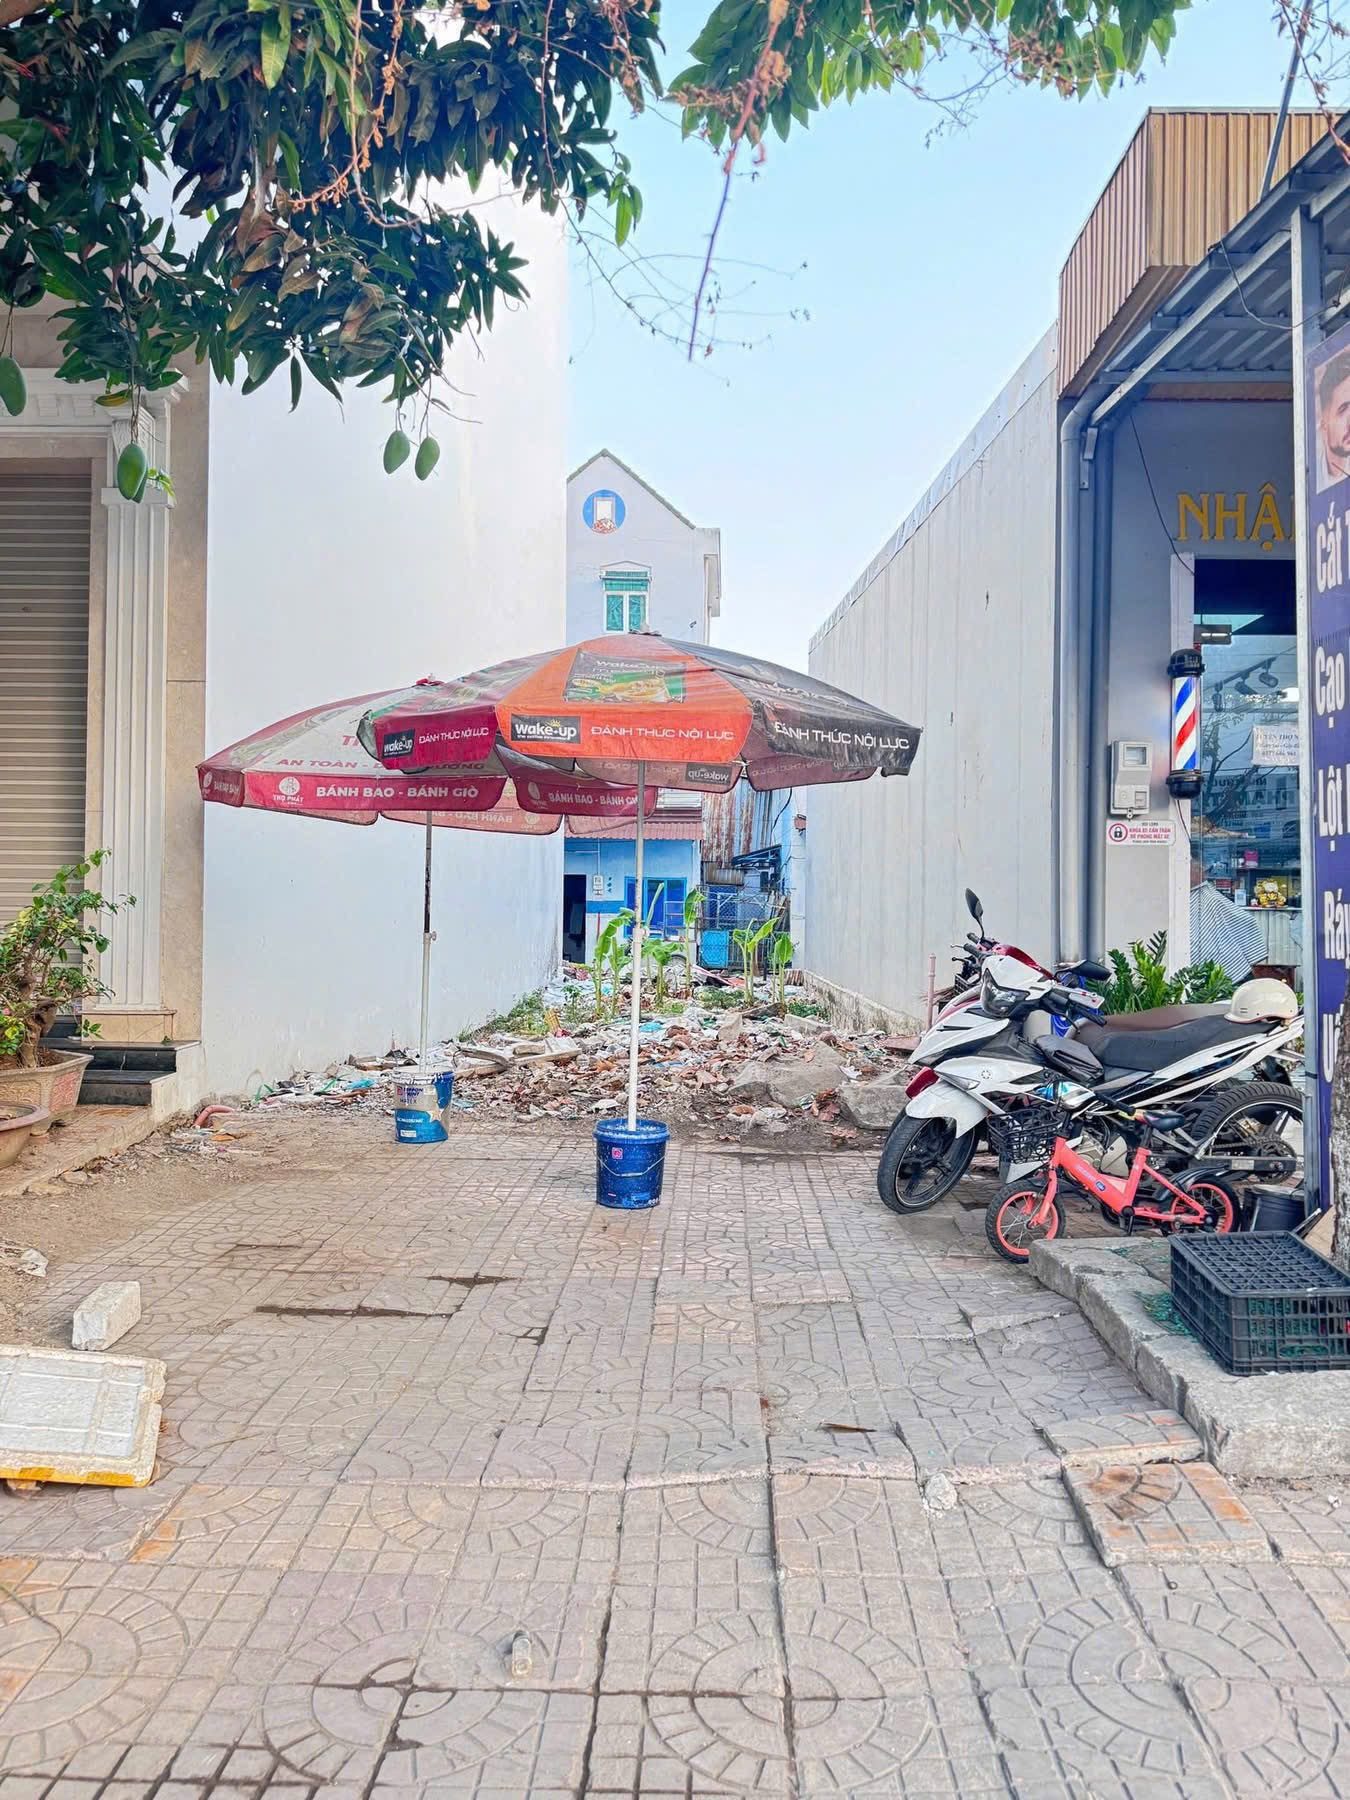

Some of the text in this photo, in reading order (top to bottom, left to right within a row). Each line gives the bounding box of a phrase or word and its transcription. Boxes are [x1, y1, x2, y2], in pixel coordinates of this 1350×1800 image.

[1176, 482, 1295, 552] NHẬ
[1316, 501, 1342, 593] Cắt
[1315, 646, 1345, 729] Cạo
[591, 725, 632, 736] ĐÁNH
[679, 728, 703, 740] NỘI
[706, 730, 735, 741] LỰC
[812, 728, 851, 744] THỨC
[854, 732, 876, 750] NỘI
[879, 737, 910, 751] LỰC
[316, 784, 358, 797] BÁNH
[363, 787, 395, 797] BAO
[407, 784, 448, 797] BÁNH
[452, 785, 479, 798] GIÒ
[1318, 765, 1343, 852] Lột
